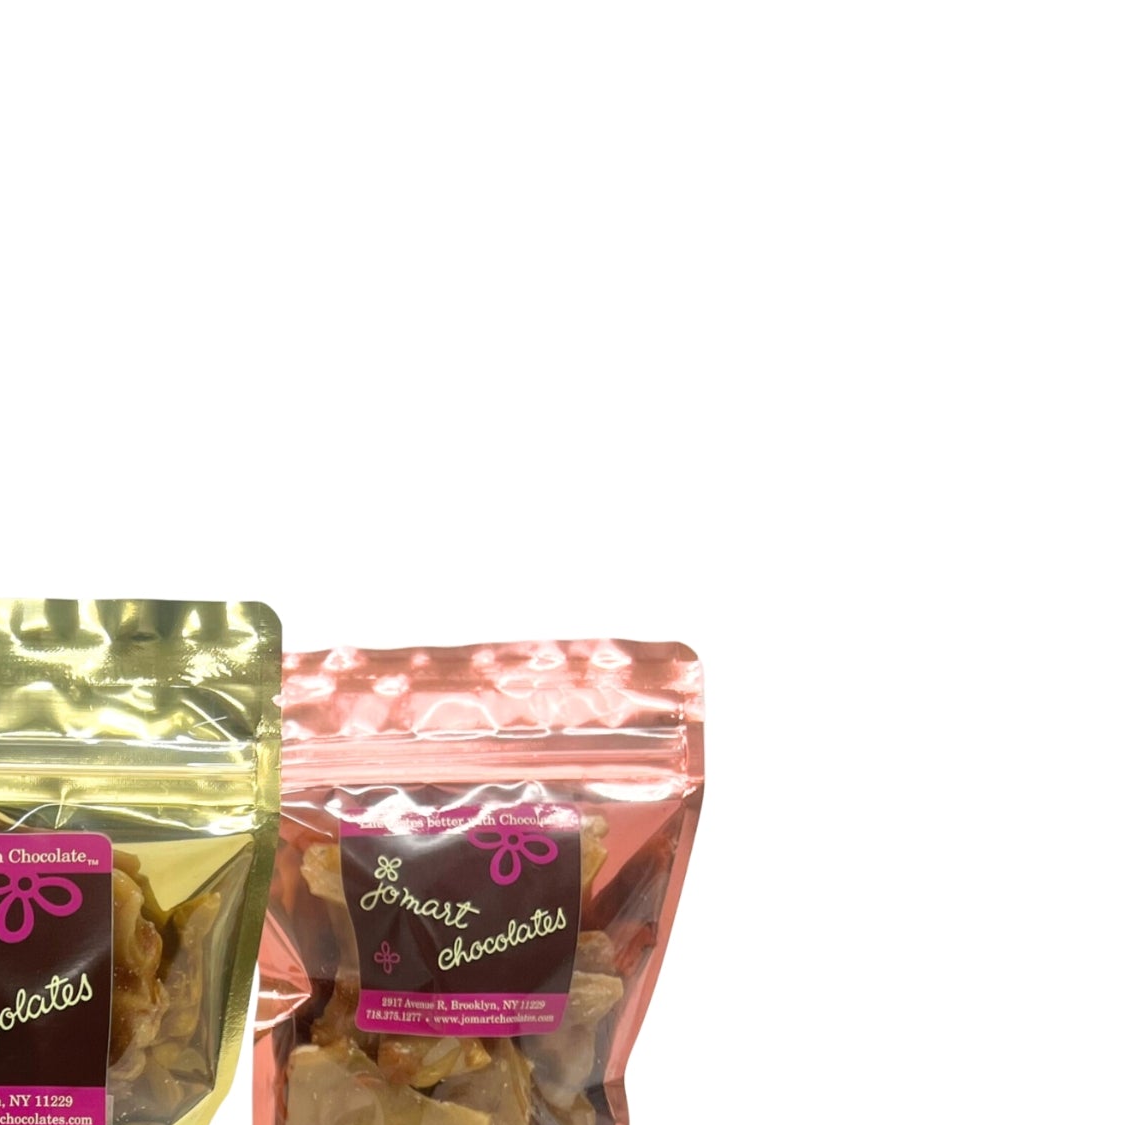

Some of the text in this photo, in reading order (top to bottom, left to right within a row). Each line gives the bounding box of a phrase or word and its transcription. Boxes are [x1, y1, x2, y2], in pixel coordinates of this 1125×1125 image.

[427, 815, 464, 828] better
[438, 907, 567, 970] chocolates
[437, 1000, 447, 1011] R,
[451, 1000, 500, 1012] Brooklyn,
[503, 1000, 518, 1010] NY
[519, 1001, 545, 1010] 11229
[9, 1095, 31, 1107] NY
[35, 1095, 74, 1108] 11229
